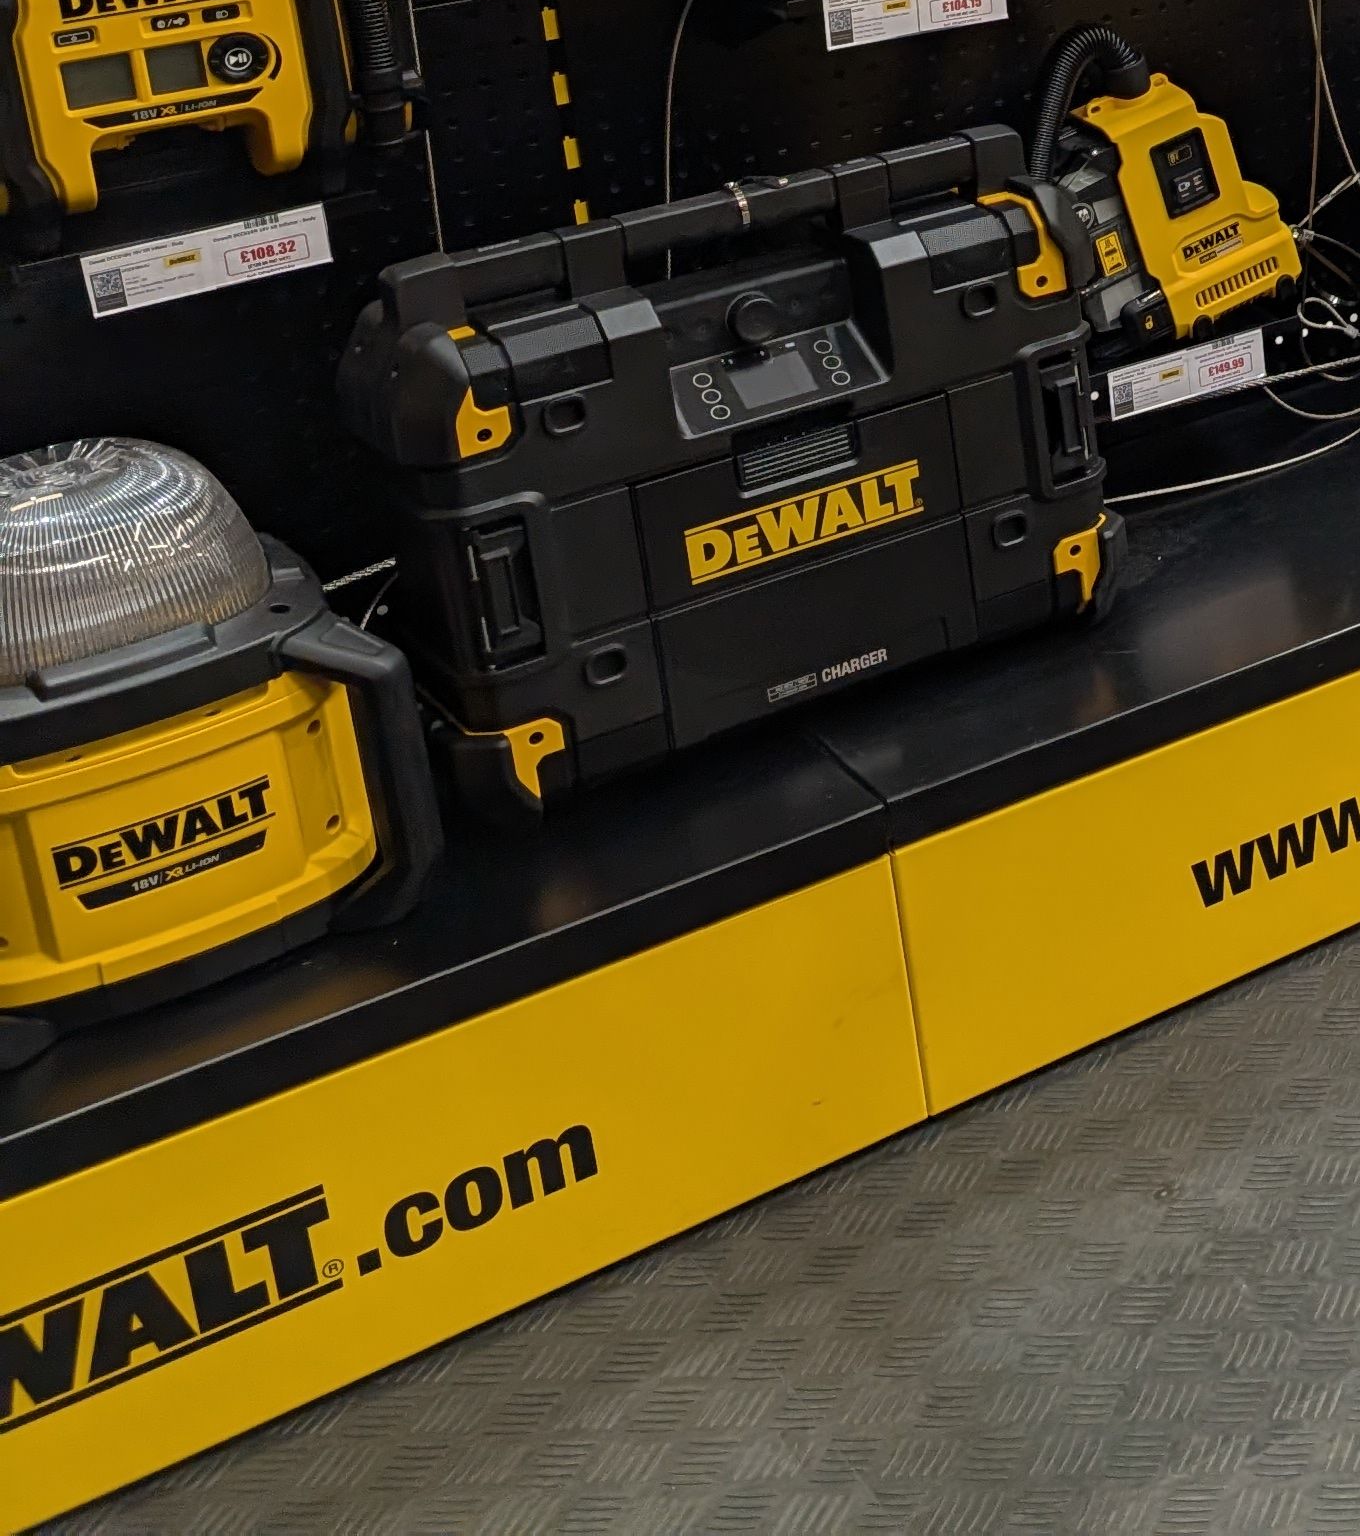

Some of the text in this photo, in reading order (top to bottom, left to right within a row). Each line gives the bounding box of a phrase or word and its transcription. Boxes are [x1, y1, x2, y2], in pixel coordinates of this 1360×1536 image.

[132, 108, 157, 121] 18V
[239, 239, 297, 265] £108.32
[821, 647, 889, 684] CHARGER
[132, 874, 160, 892] 18V
